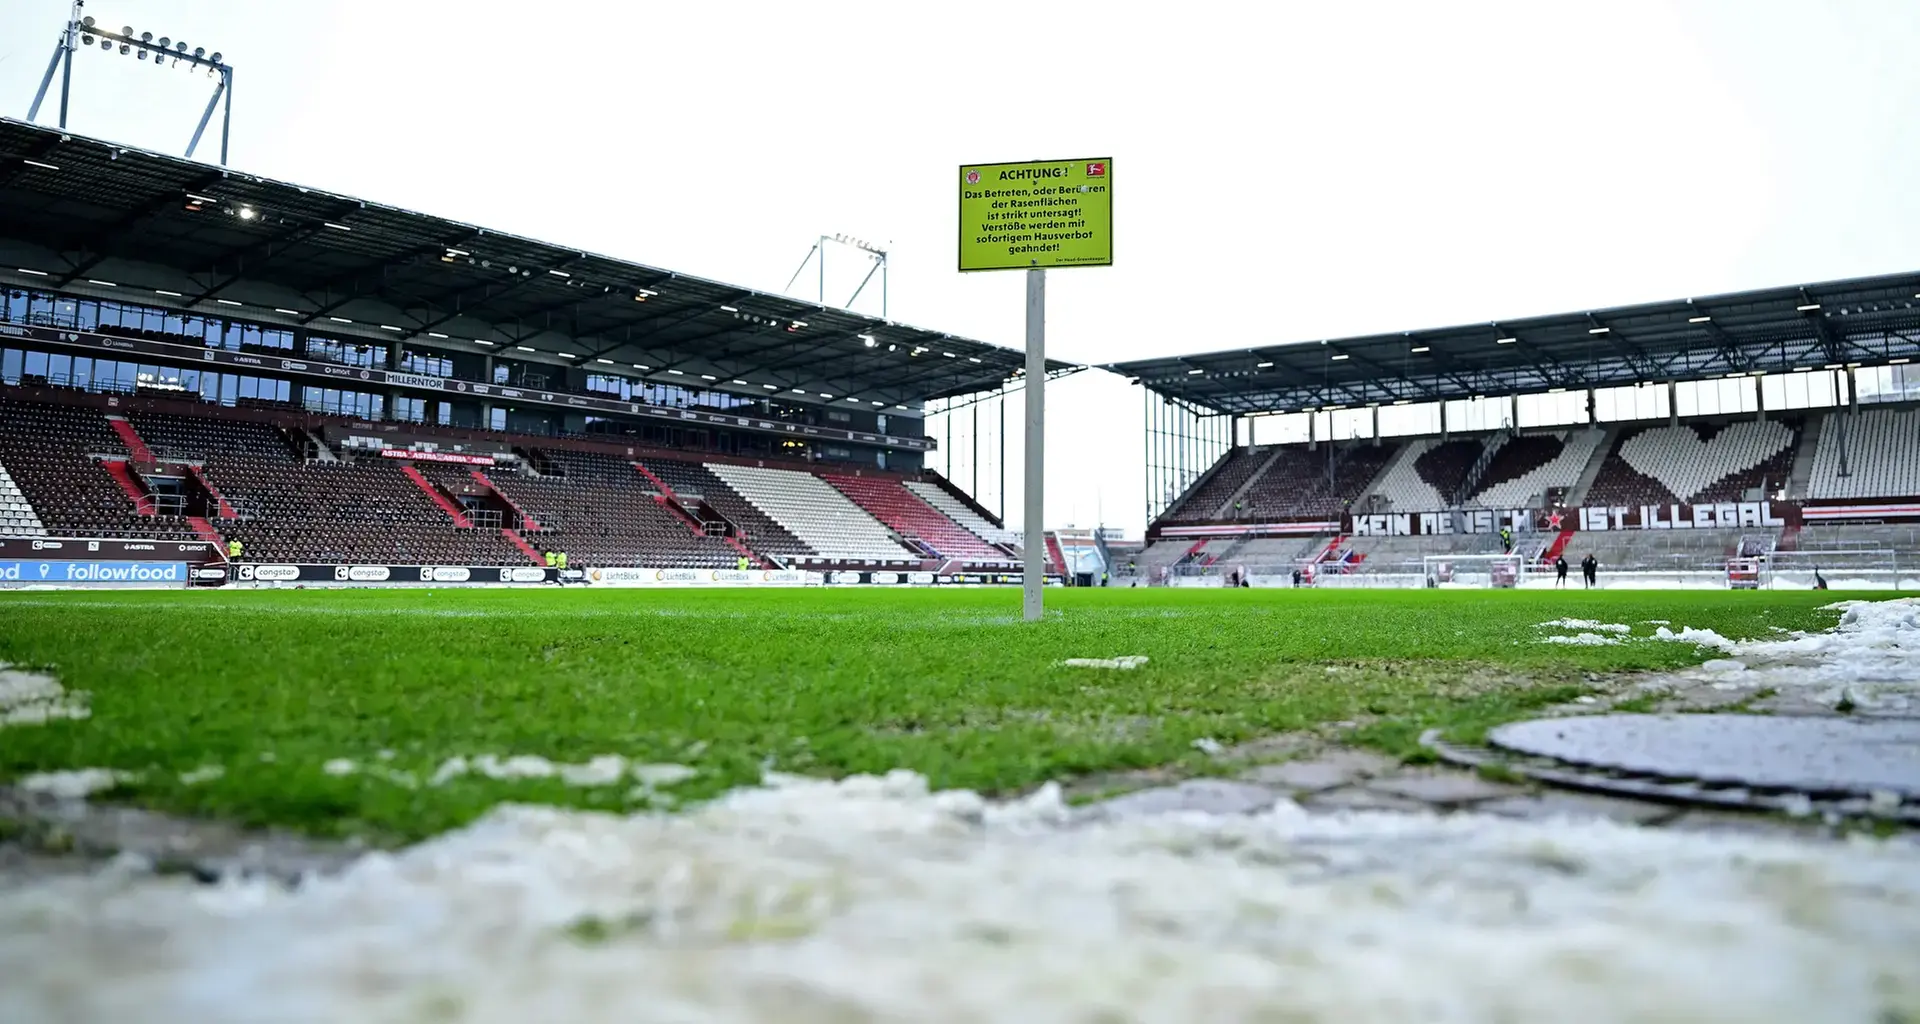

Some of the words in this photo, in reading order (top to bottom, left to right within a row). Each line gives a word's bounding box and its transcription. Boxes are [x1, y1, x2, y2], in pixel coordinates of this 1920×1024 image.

[965, 190, 982, 199] Das
[985, 188, 1031, 198] Betreten,
[1033, 186, 1057, 195] oder
[1059, 185, 1105, 194] Berüren
[992, 200, 1009, 209] der
[1010, 197, 1077, 208] Rasenflächen
[987, 211, 999, 220] ist
[1001, 210, 1028, 220] strikt
[1030, 208, 1081, 219] untersagt!
[982, 221, 1026, 232] Verstöße
[1028, 221, 1066, 230] werden
[1068, 219, 1085, 228] mit
[976, 233, 1032, 244] sofortigem
[1034, 230, 1093, 241] Hausverbot
[1008, 243, 1060, 255] geahndet!
[238, 357, 262, 365] ASTRA
[332, 368, 351, 376] smart
[387, 374, 443, 389] MILLERNTOR
[381, 449, 407, 458] ASTRA
[412, 452, 437, 461] ASTRA
[443, 455, 467, 463] ASTRA
[471, 457, 495, 465] ASTRA
[1352, 514, 1411, 536] KEIN
[1420, 508, 1532, 535] MENSCH
[1579, 507, 1628, 531] IST
[1641, 502, 1785, 530] ILLEGAL
[67, 563, 176, 580] followfood
[259, 568, 296, 578] congstar
[353, 569, 386, 578] congstar
[437, 570, 467, 578] congstar
[515, 571, 542, 579] congstar
[606, 571, 640, 580] LichtBlick
